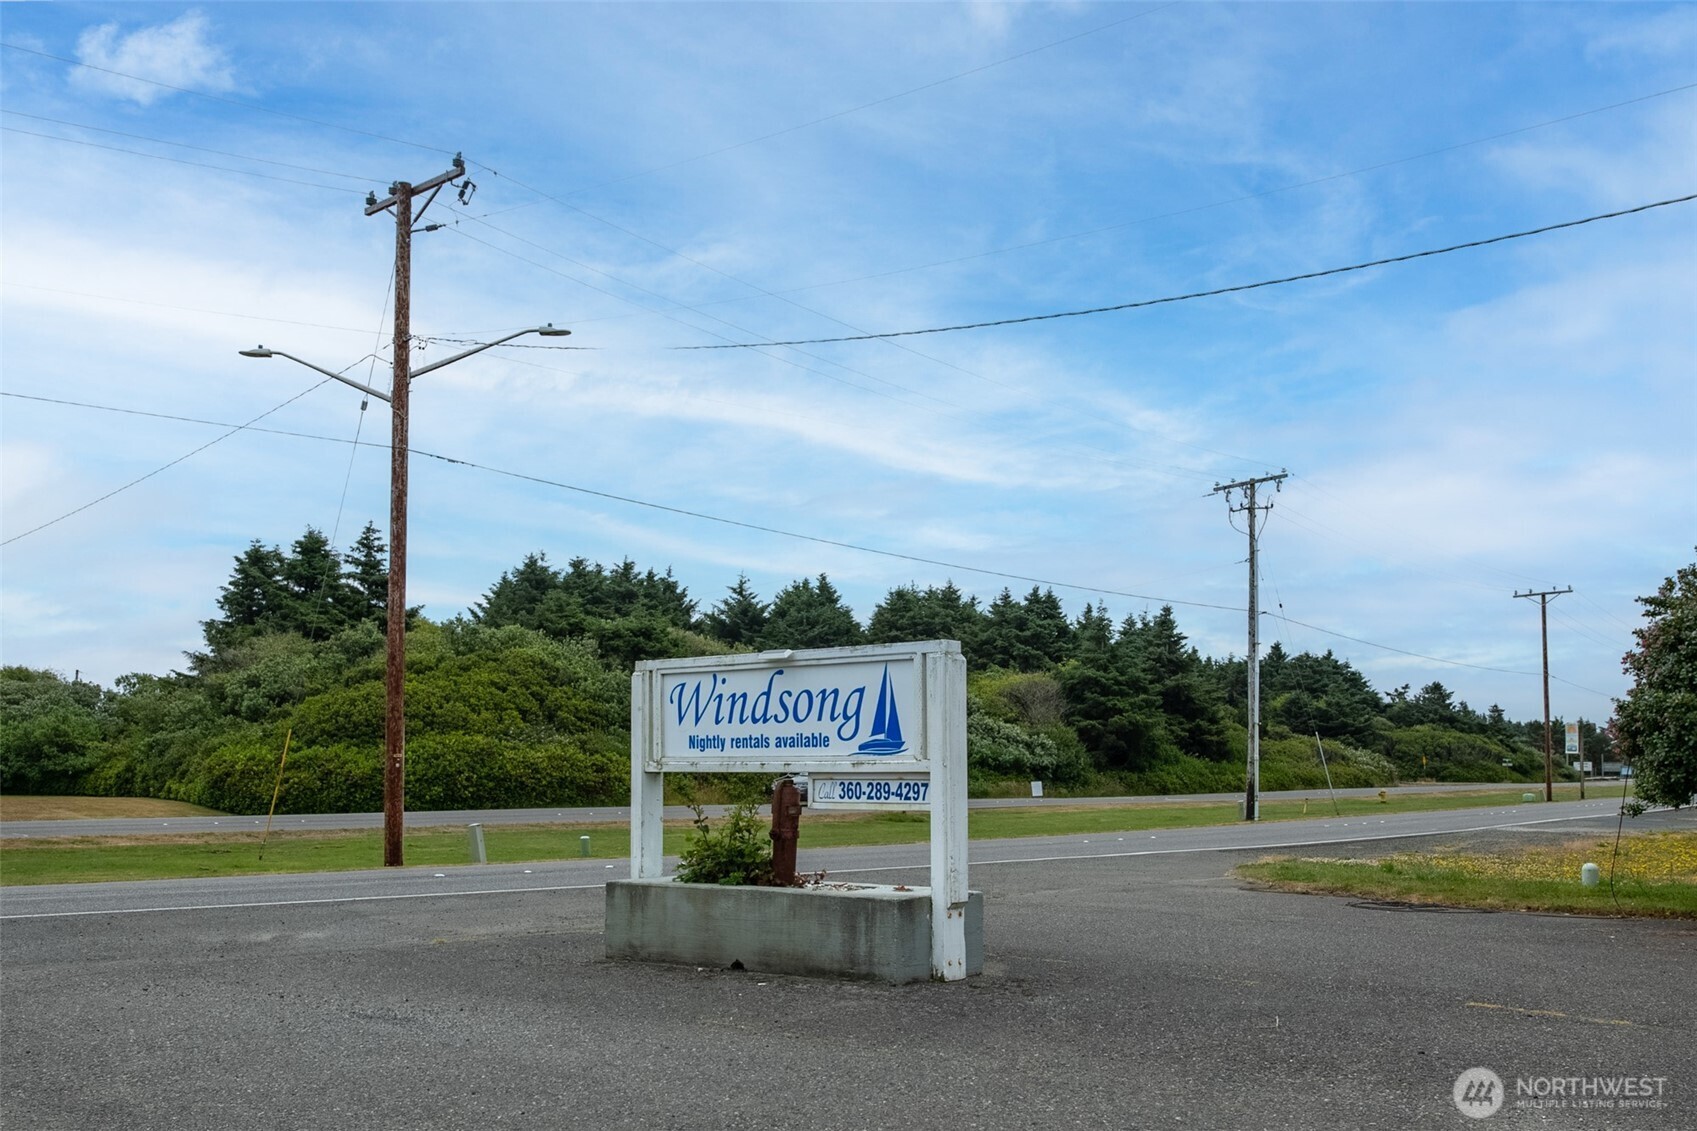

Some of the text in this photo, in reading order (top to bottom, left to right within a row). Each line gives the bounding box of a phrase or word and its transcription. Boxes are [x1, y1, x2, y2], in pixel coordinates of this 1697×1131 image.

[669, 669, 866, 741] Windsong
[688, 732, 830, 752] Nightly rentals available
[818, 781, 929, 801] Call 360-289-4297
